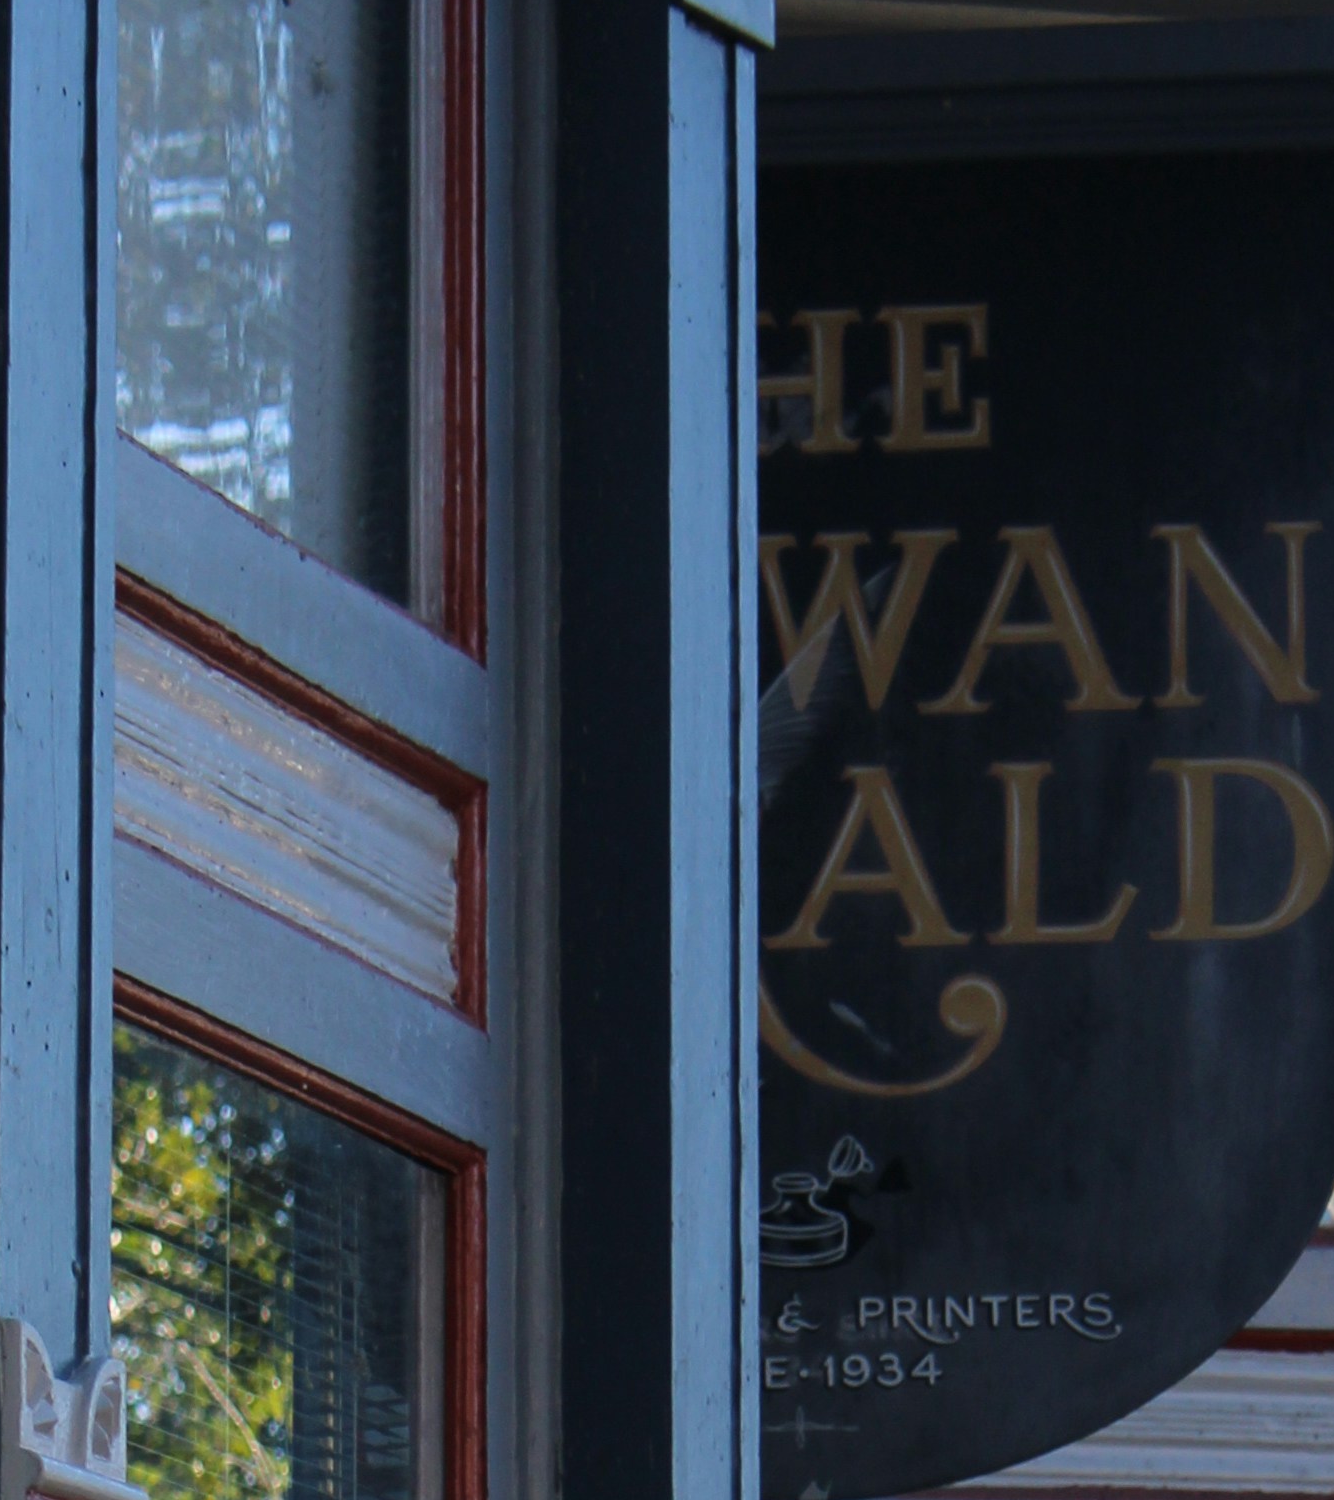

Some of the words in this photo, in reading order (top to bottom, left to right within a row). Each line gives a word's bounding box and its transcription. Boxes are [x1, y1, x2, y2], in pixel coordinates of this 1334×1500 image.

[757, 302, 992, 454] HE
[759, 521, 1324, 716] WAN
[764, 757, 1334, 950] ALD
[777, 1292, 821, 1335] &
[858, 1291, 1123, 1345] PRINTERS
